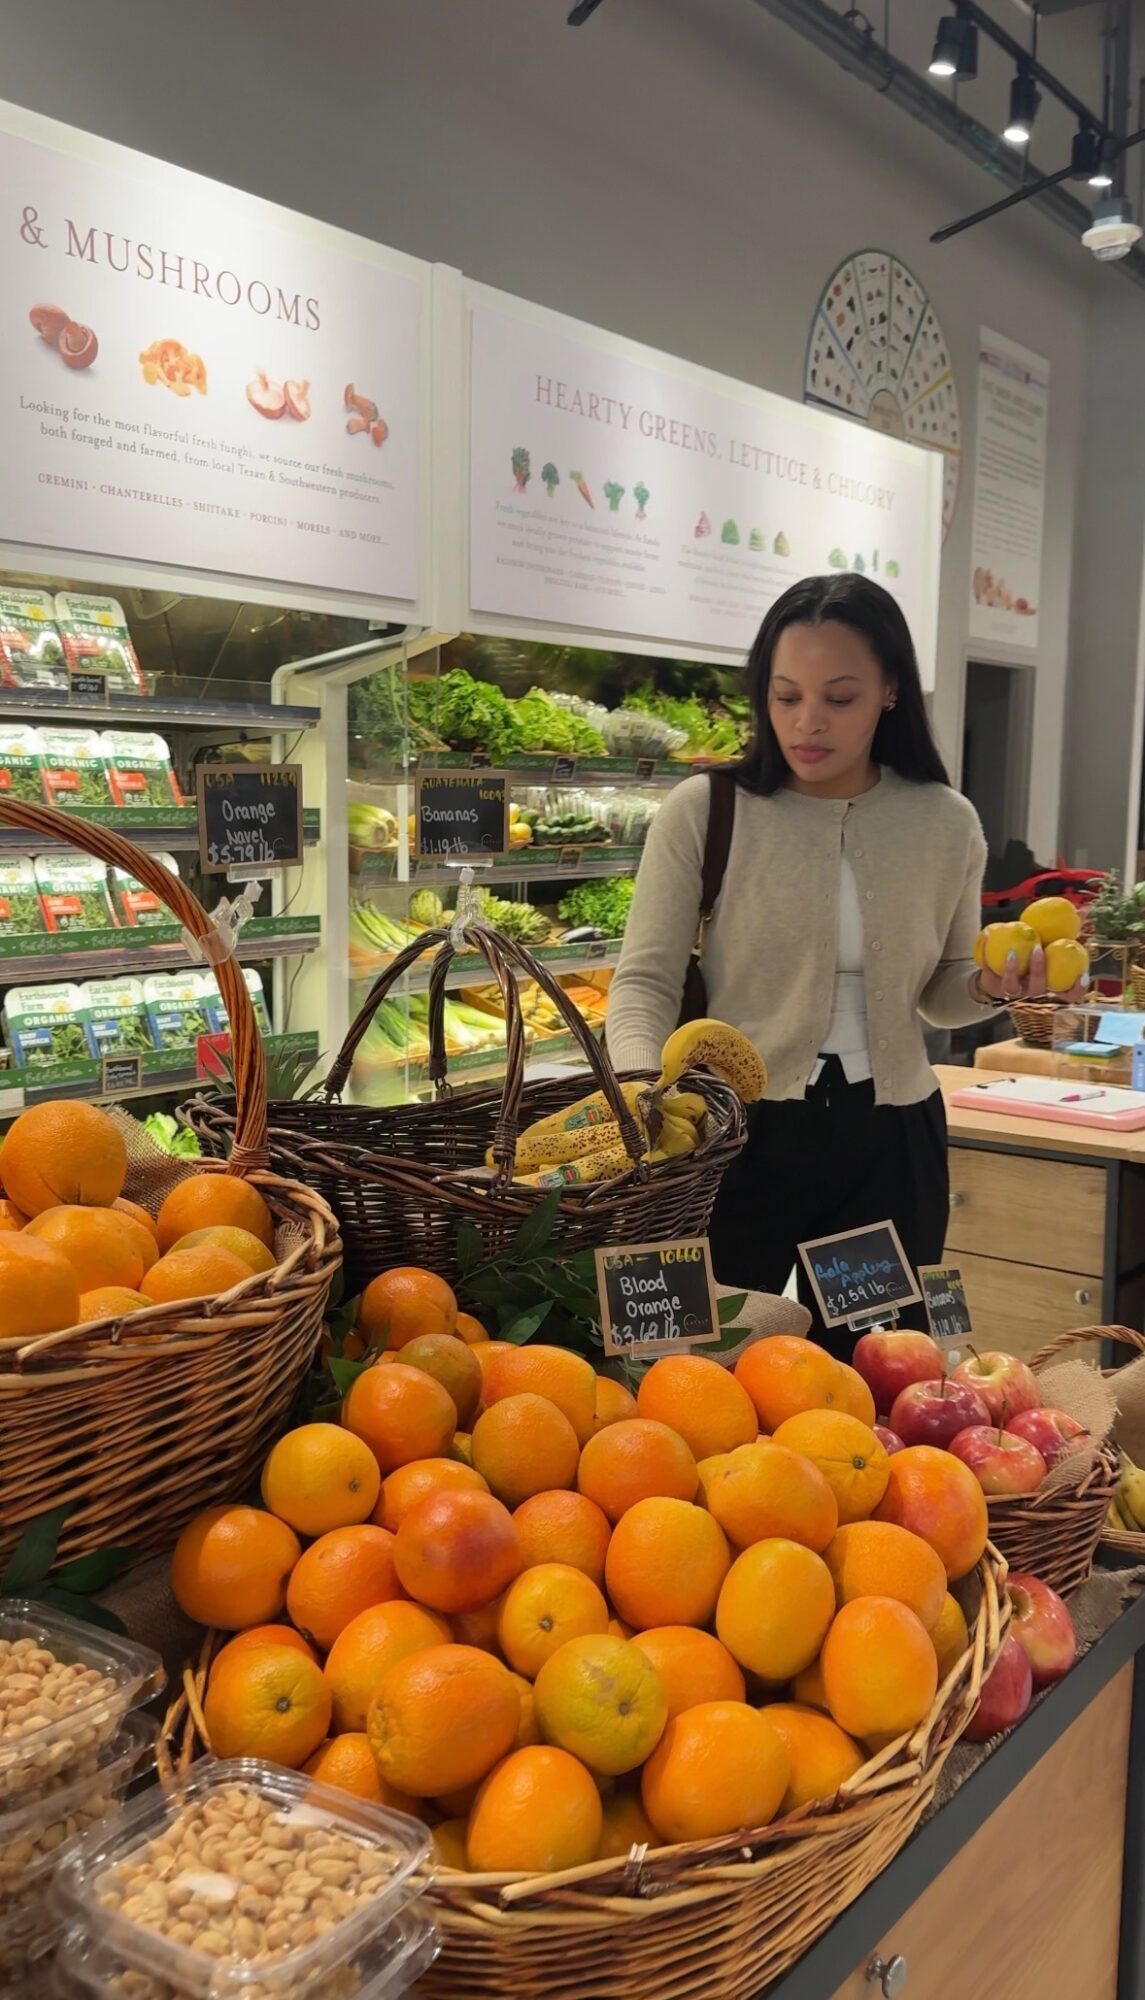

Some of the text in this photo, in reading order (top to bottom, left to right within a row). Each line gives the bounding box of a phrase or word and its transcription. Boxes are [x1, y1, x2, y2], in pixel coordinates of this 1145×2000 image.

[20, 206, 321, 331] & MUSHROOMS
[20, 395, 70, 422] Looking
[72, 407, 90, 422] for
[93, 413, 110, 427] the
[115, 420, 140, 433] most
[143, 424, 189, 444] flavorful
[192, 434, 217, 450] fresh
[259, 453, 270, 462] we
[273, 455, 302, 469] source
[304, 463, 320, 472] our
[322, 463, 344, 478] fresh
[536, 375, 633, 430] HEARTY
[729, 439, 808, 486] LETTUCE
[813, 467, 823, 490] &
[828, 472, 896, 511] CHICORY
[41, 422, 67, 440] both
[71, 428, 113, 450] foraged
[117, 441, 136, 453] and
[184, 452, 209, 468] from
[212, 457, 235, 473] local
[238, 463, 265, 480] Texan
[268, 471, 276, 482] &
[279, 472, 337, 495] Southwestern
[38, 473, 88, 491] CREMINI
[100, 484, 183, 508] CHANTERELLES
[193, 501, 240, 518] SHIITAKE
[250, 512, 287, 527] PORCINI
[297, 521, 331, 535] MORELS
[339, 529, 357, 540] AND
[73, 623, 120, 636] ORGANIC
[0, 756, 33, 767] GANIC
[50, 757, 99, 768] ORGANIC
[117, 760, 162, 770] ORGANIC
[222, 800, 276, 824] Orange
[421, 805, 479, 823] Bananas
[226, 828, 265, 845] Navel
[208, 841, 275, 867] $5.79 lb
[52, 883, 99, 893] ORGANIC
[94, 1006, 139, 1018] ORGANIC
[159, 1000, 200, 1011] ORGANIC
[23, 1012, 77, 1027] ORGANIC
[603, 1253, 634, 1270] USA
[620, 1270, 668, 1296] Blood
[826, 1285, 869, 1316] $2.59
[868, 1280, 885, 1296] lb
[626, 1296, 682, 1321] Orange
[664, 1320, 680, 1340] lb
